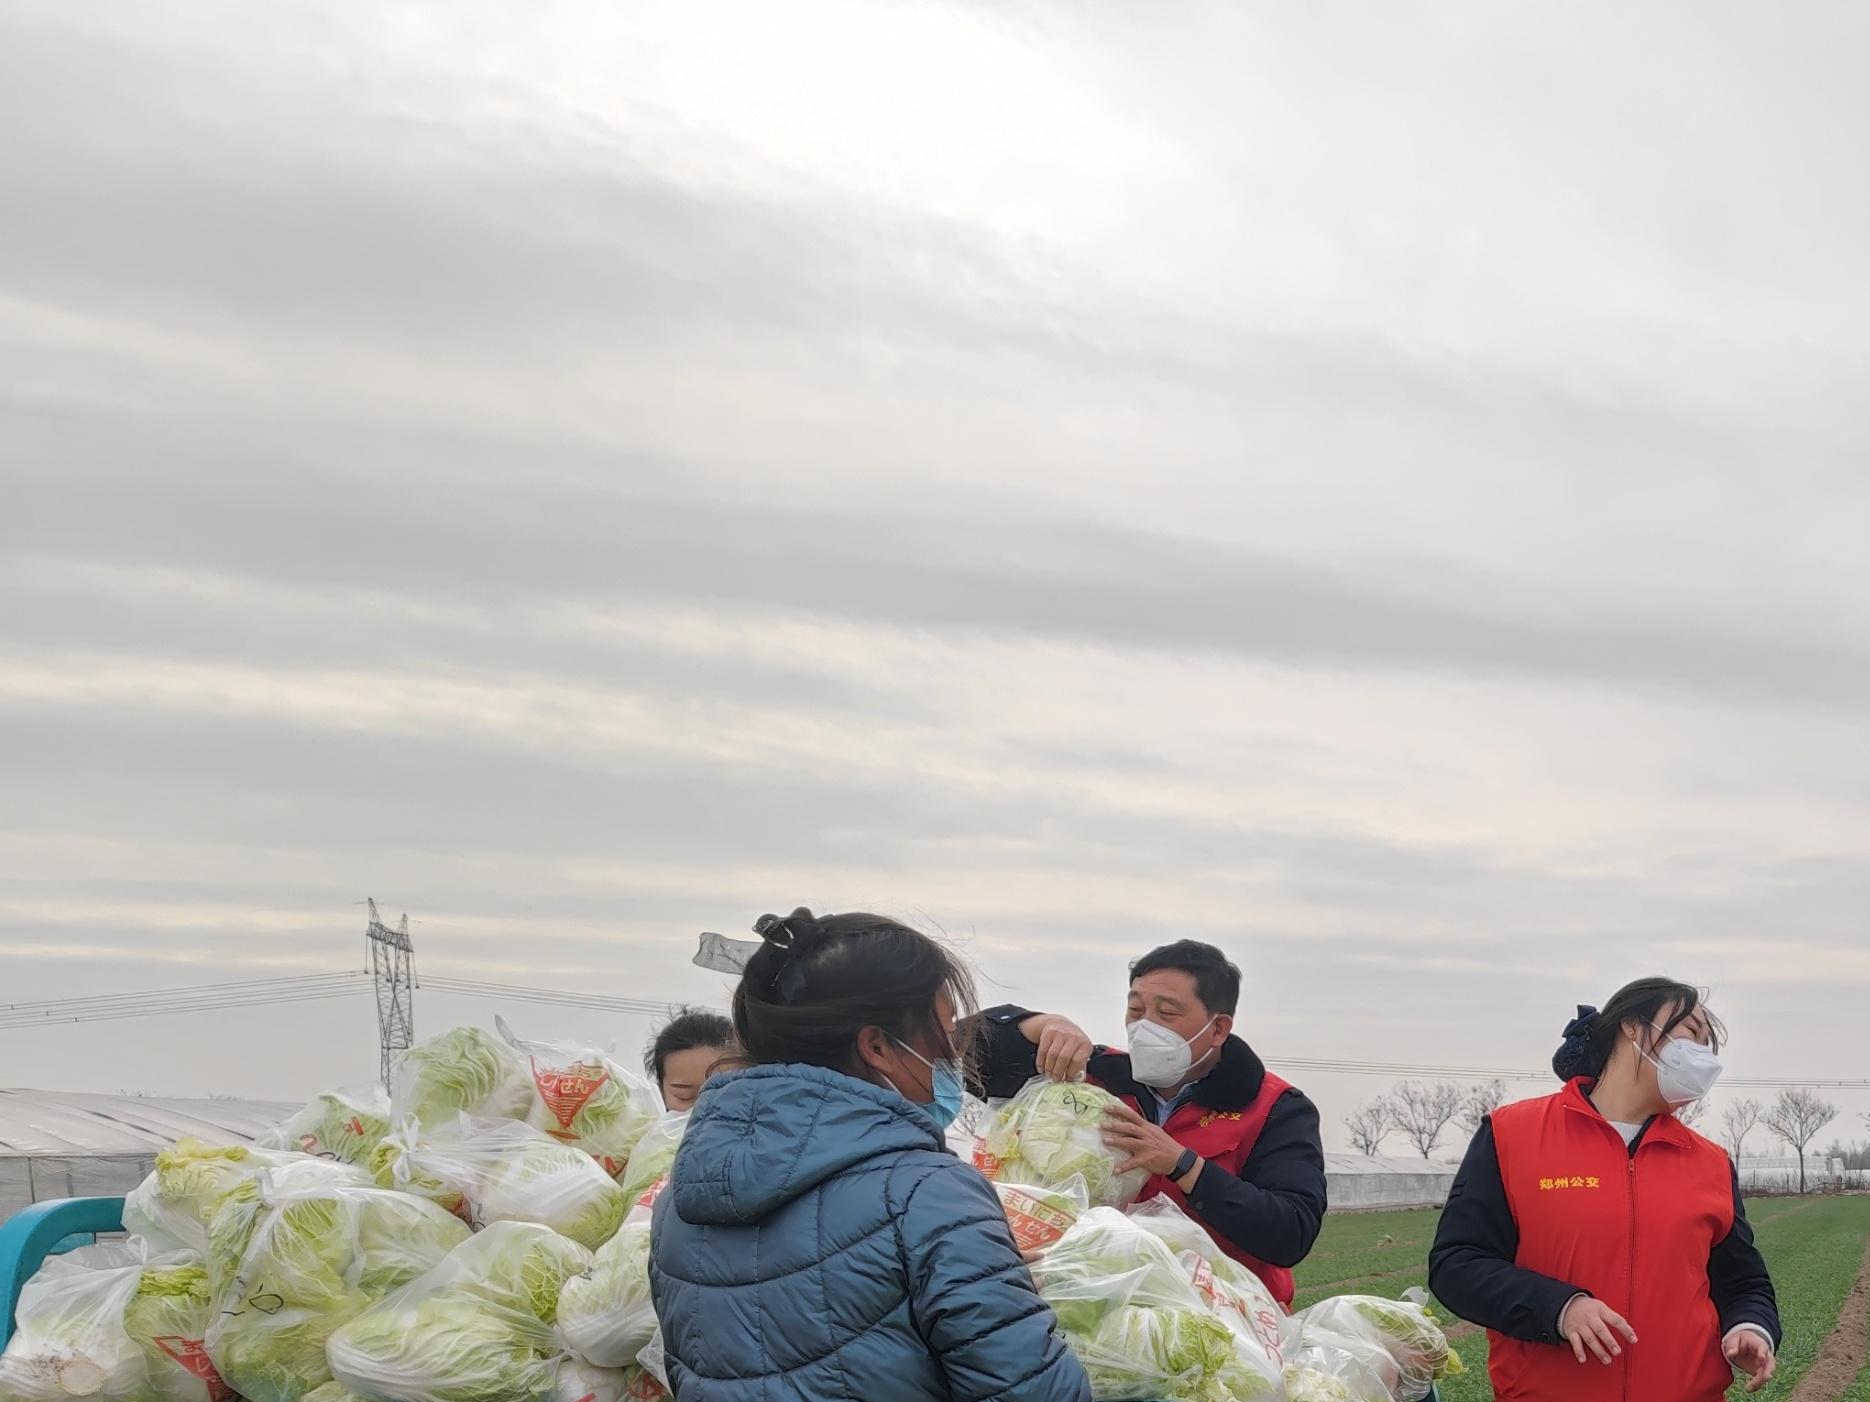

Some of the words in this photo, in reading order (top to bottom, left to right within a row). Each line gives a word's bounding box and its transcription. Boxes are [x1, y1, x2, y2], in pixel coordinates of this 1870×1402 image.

[1539, 1176, 1600, 1190] 郑州公交
[1004, 1191, 1068, 1227] まいにち
[1008, 1213, 1051, 1240] んせん
